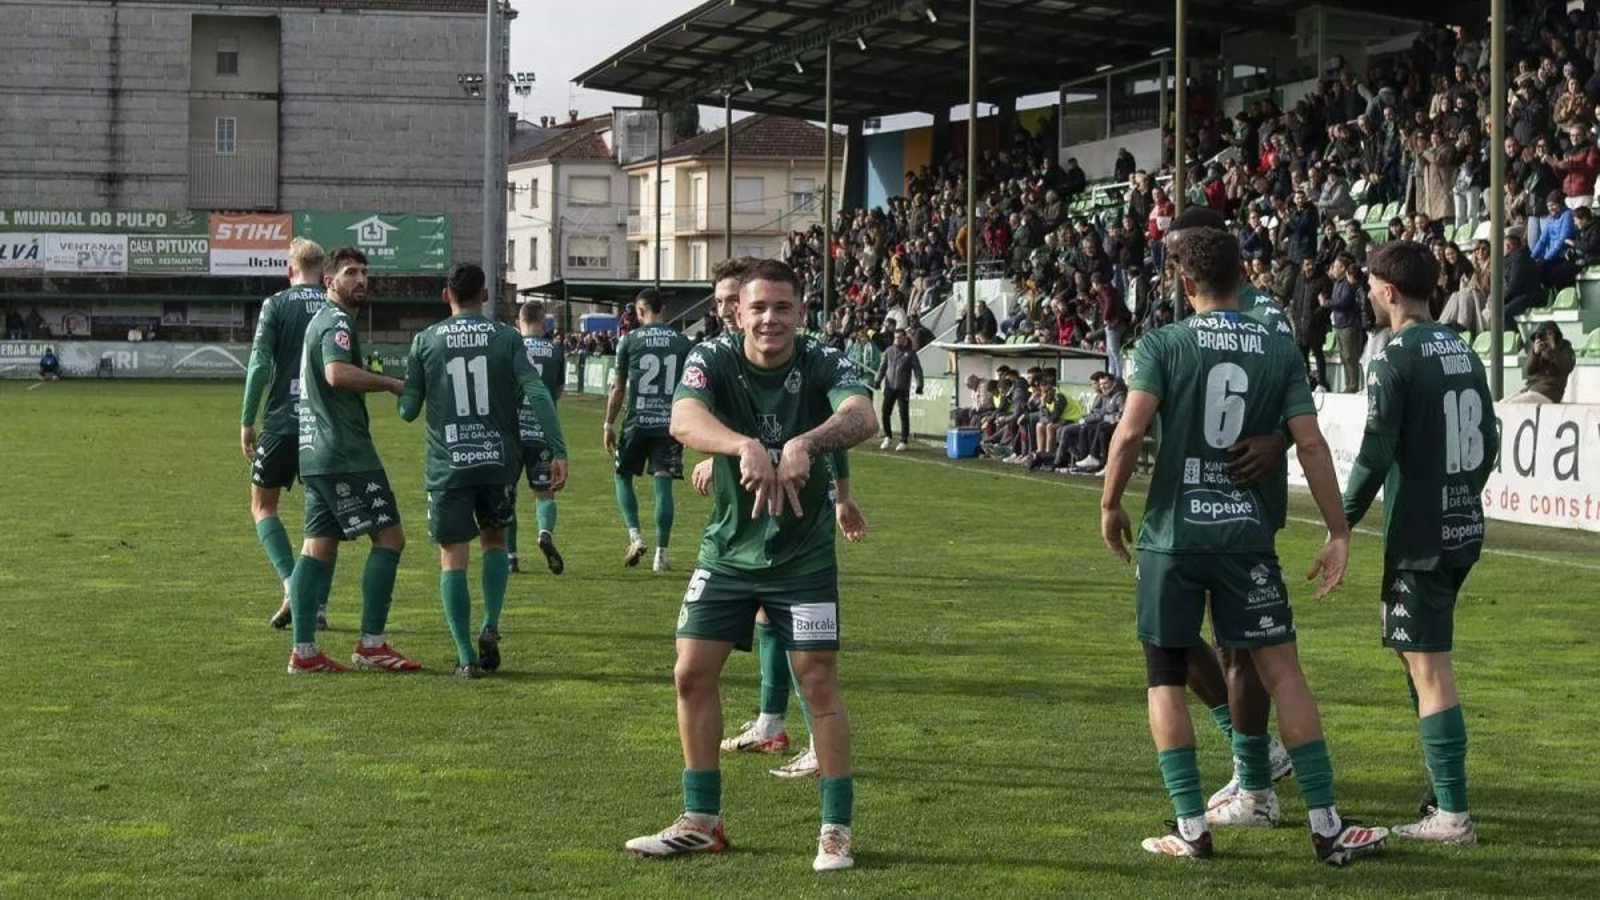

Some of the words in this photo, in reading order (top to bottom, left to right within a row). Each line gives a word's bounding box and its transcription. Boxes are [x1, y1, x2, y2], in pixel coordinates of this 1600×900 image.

[14, 211, 86, 226] MUNDIAL
[90, 212, 112, 226] DO
[116, 212, 168, 228] PULPO
[215, 223, 287, 241] STIHL
[60, 243, 124, 251] VENTANAS
[130, 240, 154, 253] CASA
[156, 239, 209, 254] PITUXO
[77, 251, 124, 266] PVC
[134, 258, 154, 266] HOTEL
[159, 257, 203, 266] RESTAURANTE
[306, 301, 322, 314] LUC
[438, 323, 497, 335] ABANCA
[637, 329, 677, 338] ABANCA
[1188, 317, 1269, 336] ABANCA
[446, 332, 489, 349] CUÉLLAR
[1197, 331, 1238, 351] BRAIS
[1239, 336, 1265, 354] VAL
[1440, 354, 1472, 375] MINGO
[638, 353, 678, 395] 21
[446, 355, 490, 416] 11
[1204, 362, 1249, 449] 6
[460, 424, 486, 432] XUNTA
[1443, 388, 1484, 474] 18
[460, 432, 470, 440] DE
[452, 451, 500, 464] Bopeixe
[1204, 461, 1228, 472] XUNT
[1203, 473, 1216, 483] DE
[1500, 485, 1520, 511] de
[1190, 499, 1252, 519] Bopeixe
[797, 619, 835, 631] Barcala
